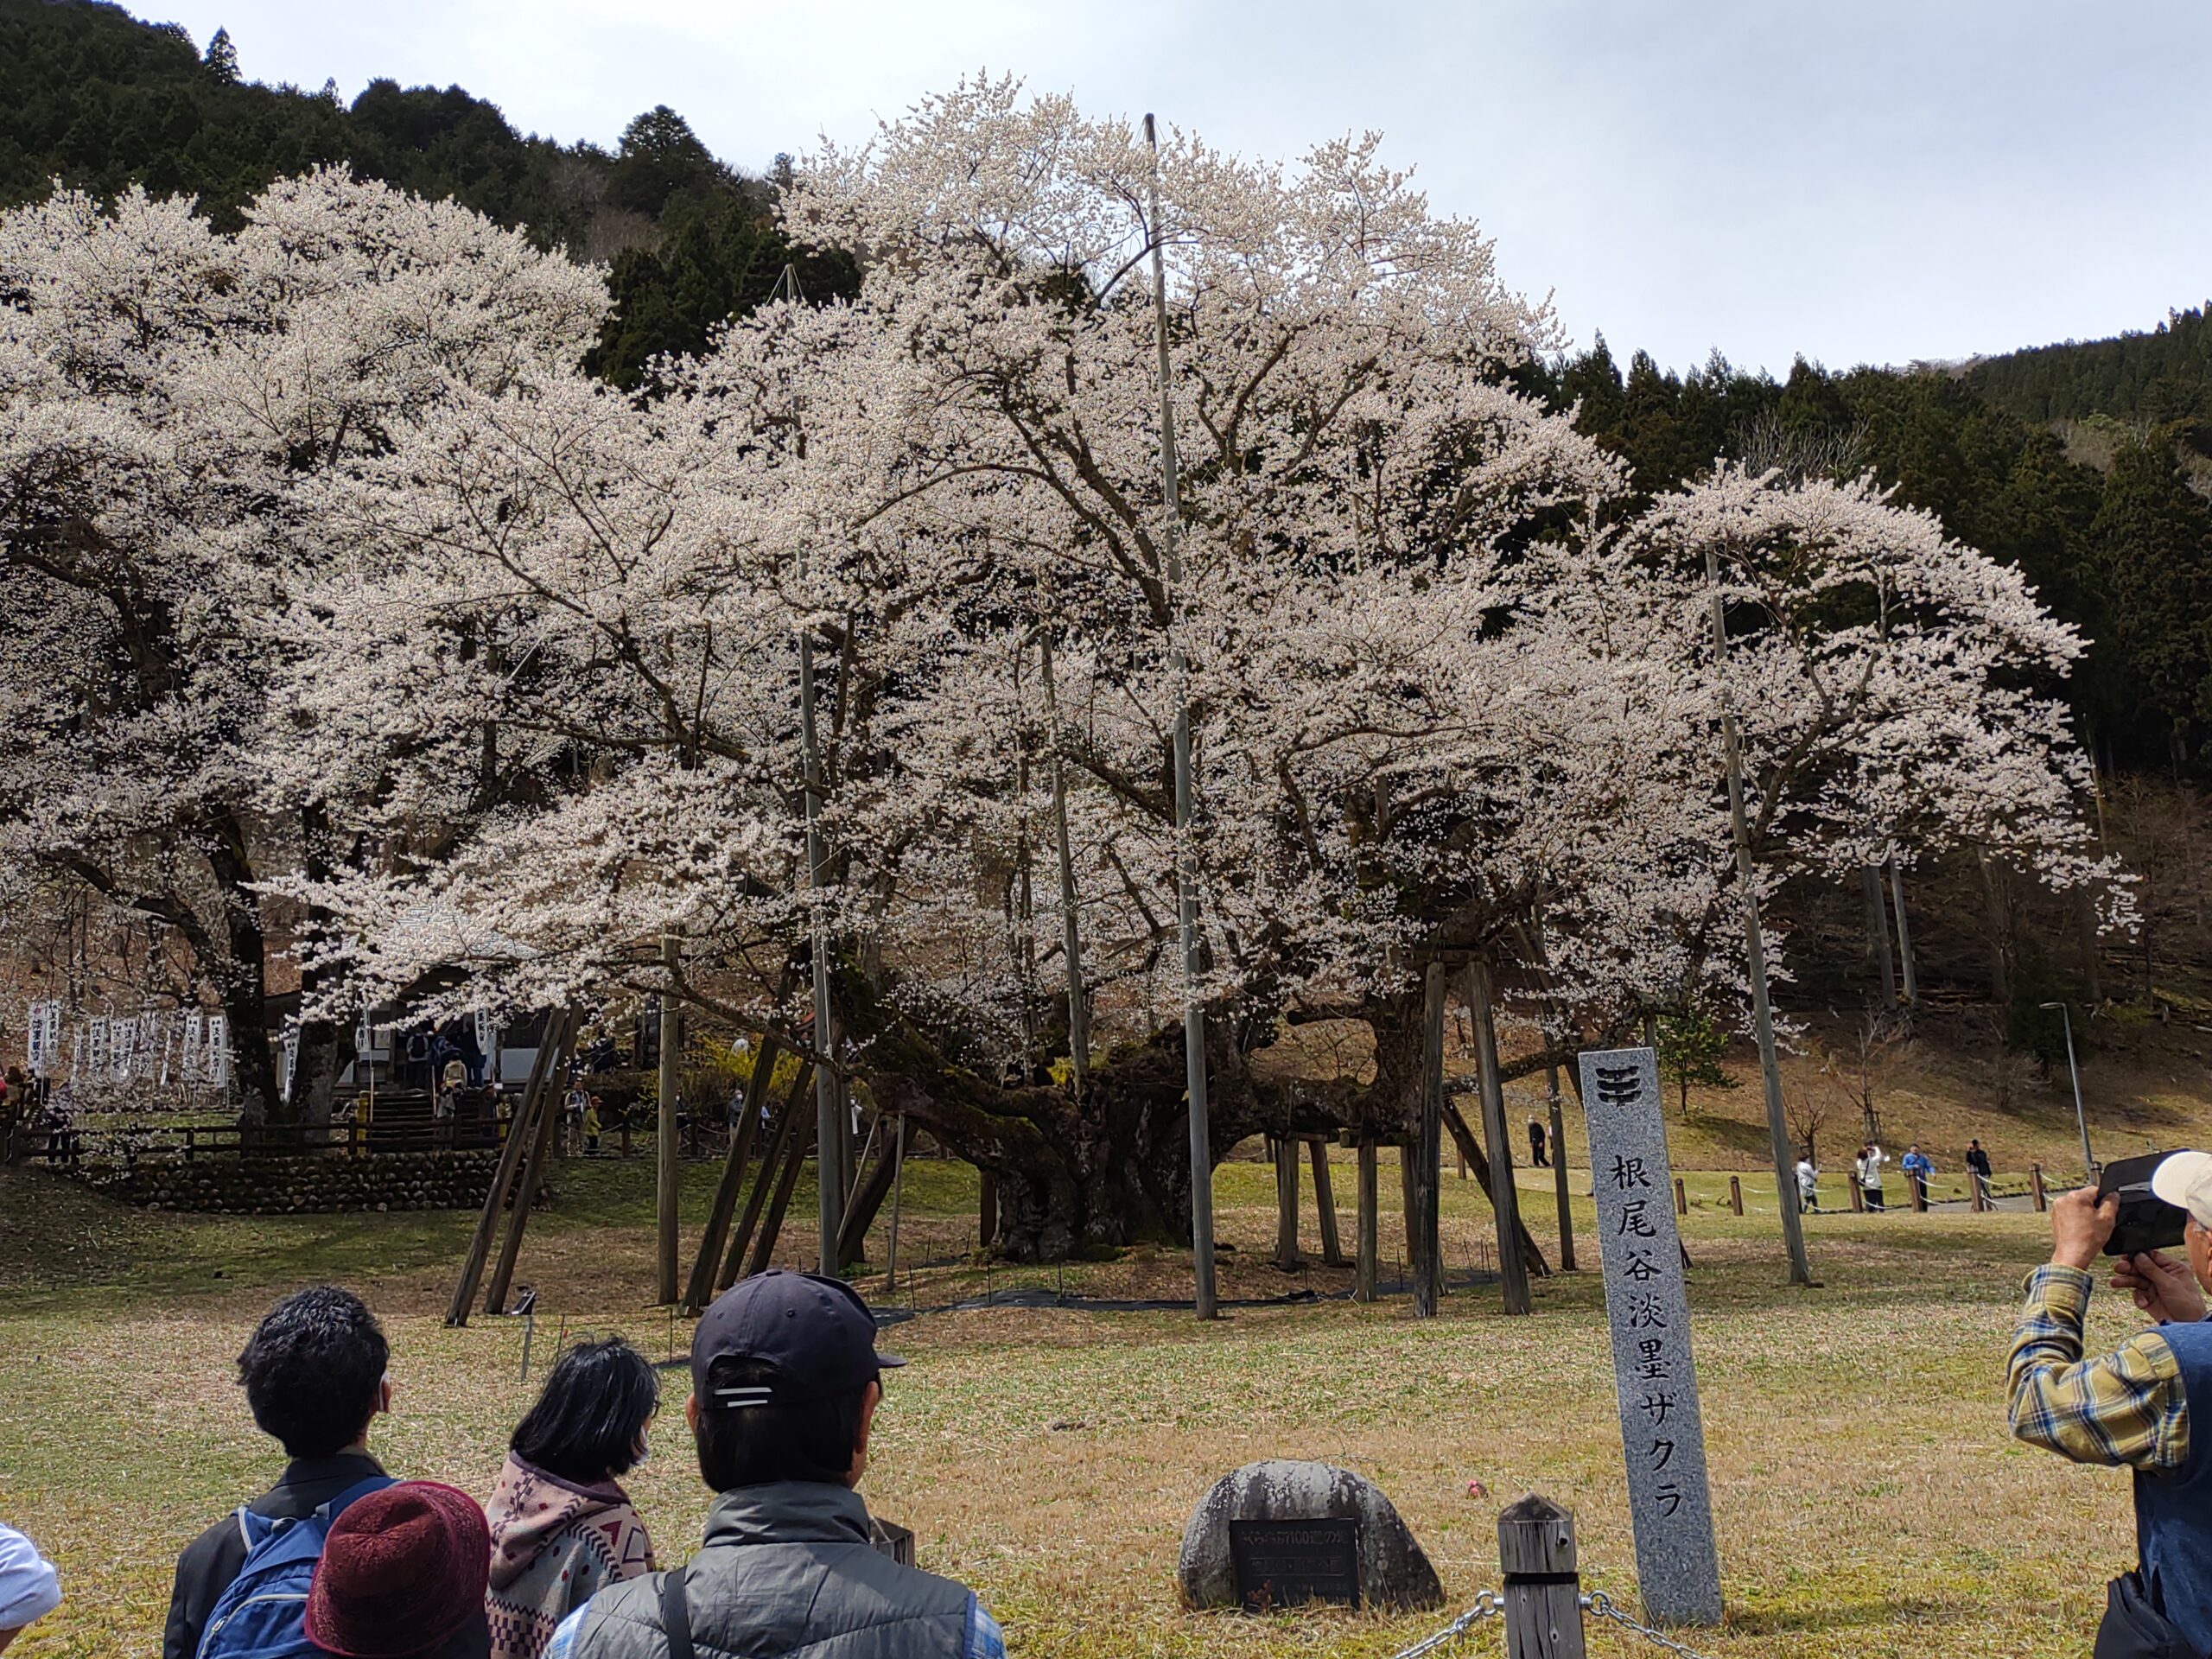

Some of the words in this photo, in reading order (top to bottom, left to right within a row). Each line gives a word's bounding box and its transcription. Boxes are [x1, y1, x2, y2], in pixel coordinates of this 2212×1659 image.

[1610, 1154, 1683, 1518] 根尾谷淡墨ザクラ
